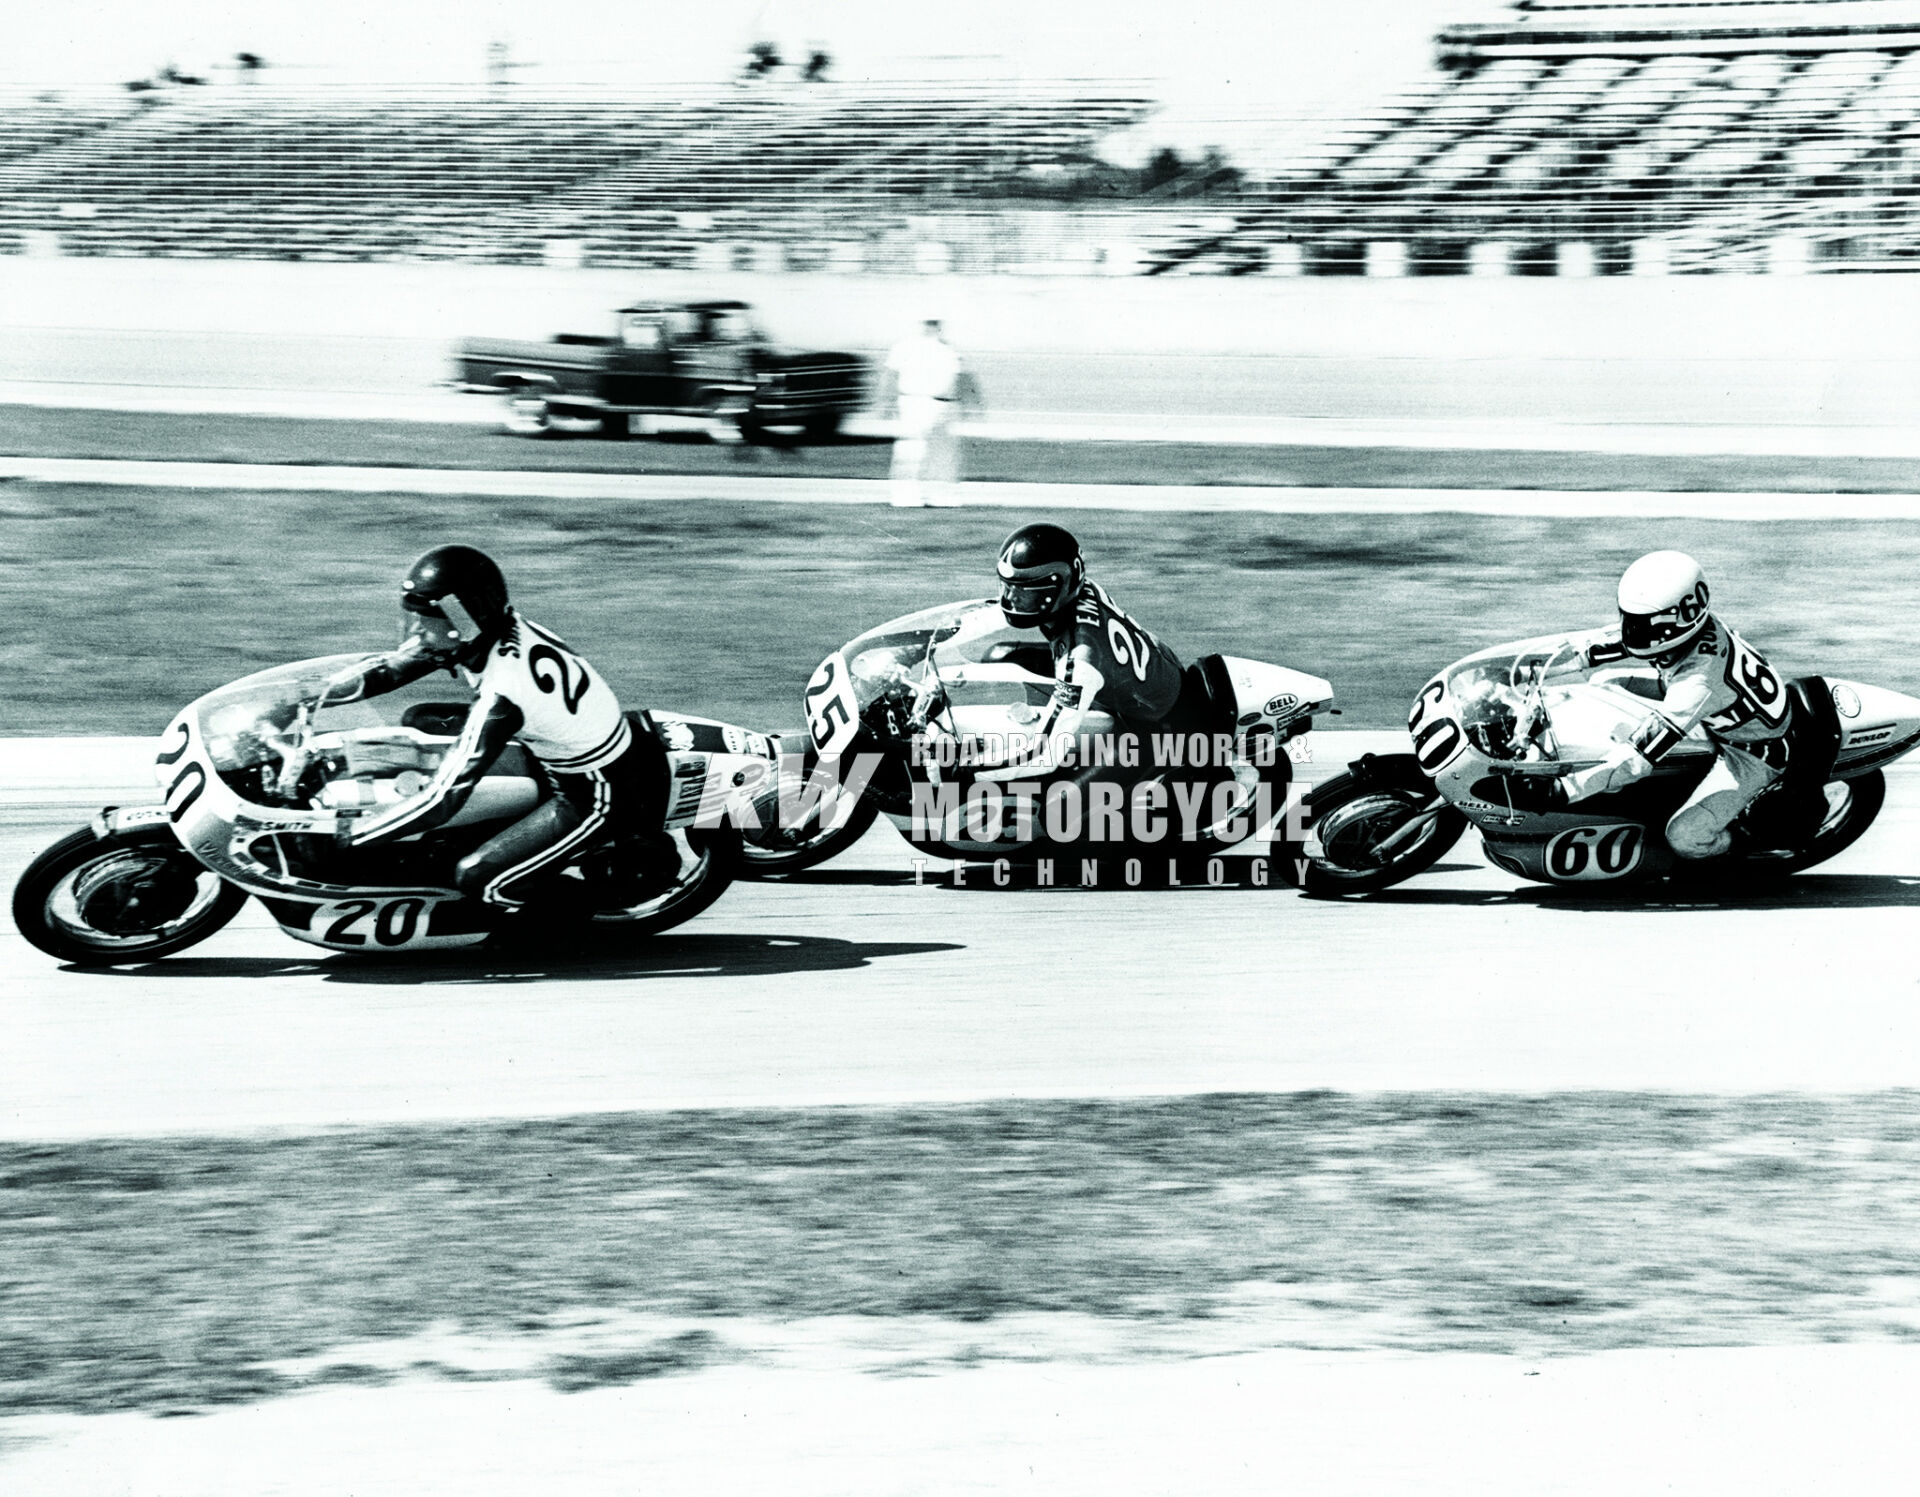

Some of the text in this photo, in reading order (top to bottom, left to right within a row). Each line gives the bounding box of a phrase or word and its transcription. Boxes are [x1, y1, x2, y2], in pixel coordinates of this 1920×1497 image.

[1679, 581, 1709, 623] 60
[805, 662, 850, 750] 25
[1269, 696, 1295, 710] BELL
[1408, 680, 1460, 770] 60
[262, 821, 314, 831] SMITH
[1551, 825, 1642, 877] 60
[323, 897, 427, 946] 20
